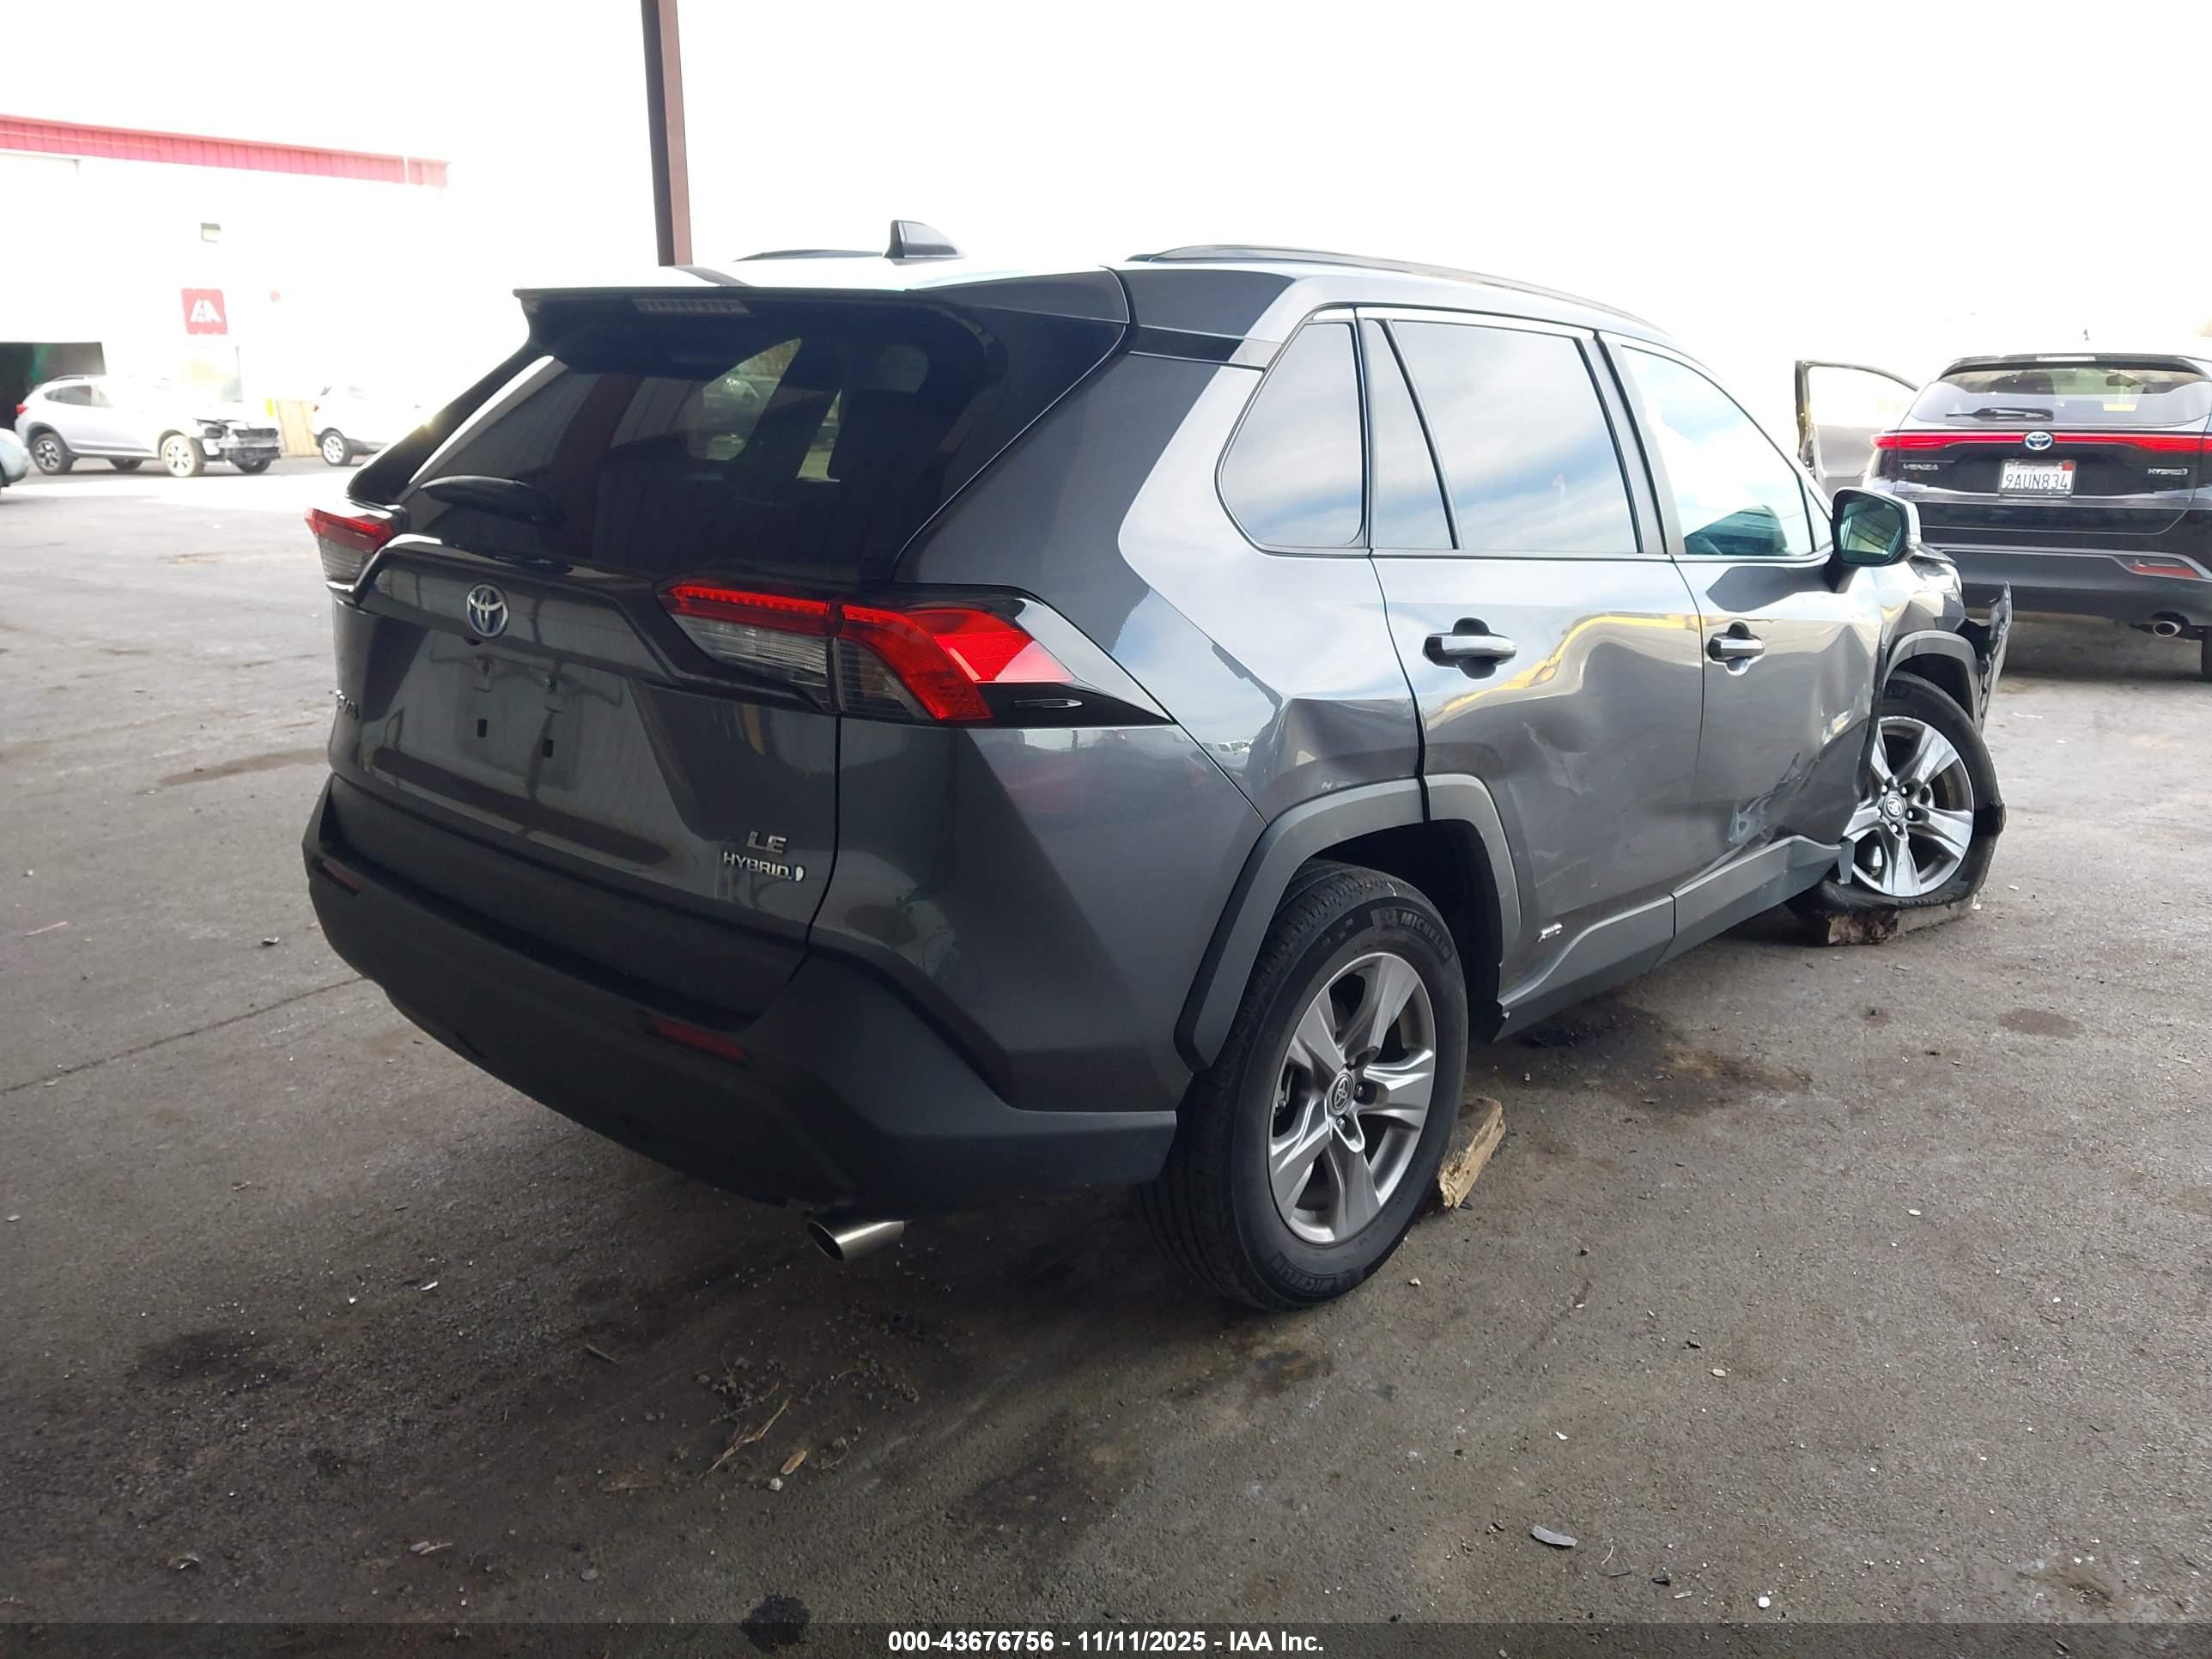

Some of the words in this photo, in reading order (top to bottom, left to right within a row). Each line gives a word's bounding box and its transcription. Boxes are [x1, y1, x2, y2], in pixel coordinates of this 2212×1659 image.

[2005, 473, 2068, 489] 9AUN834
[747, 830, 787, 854] LE
[723, 851, 790, 878] HYBRID
